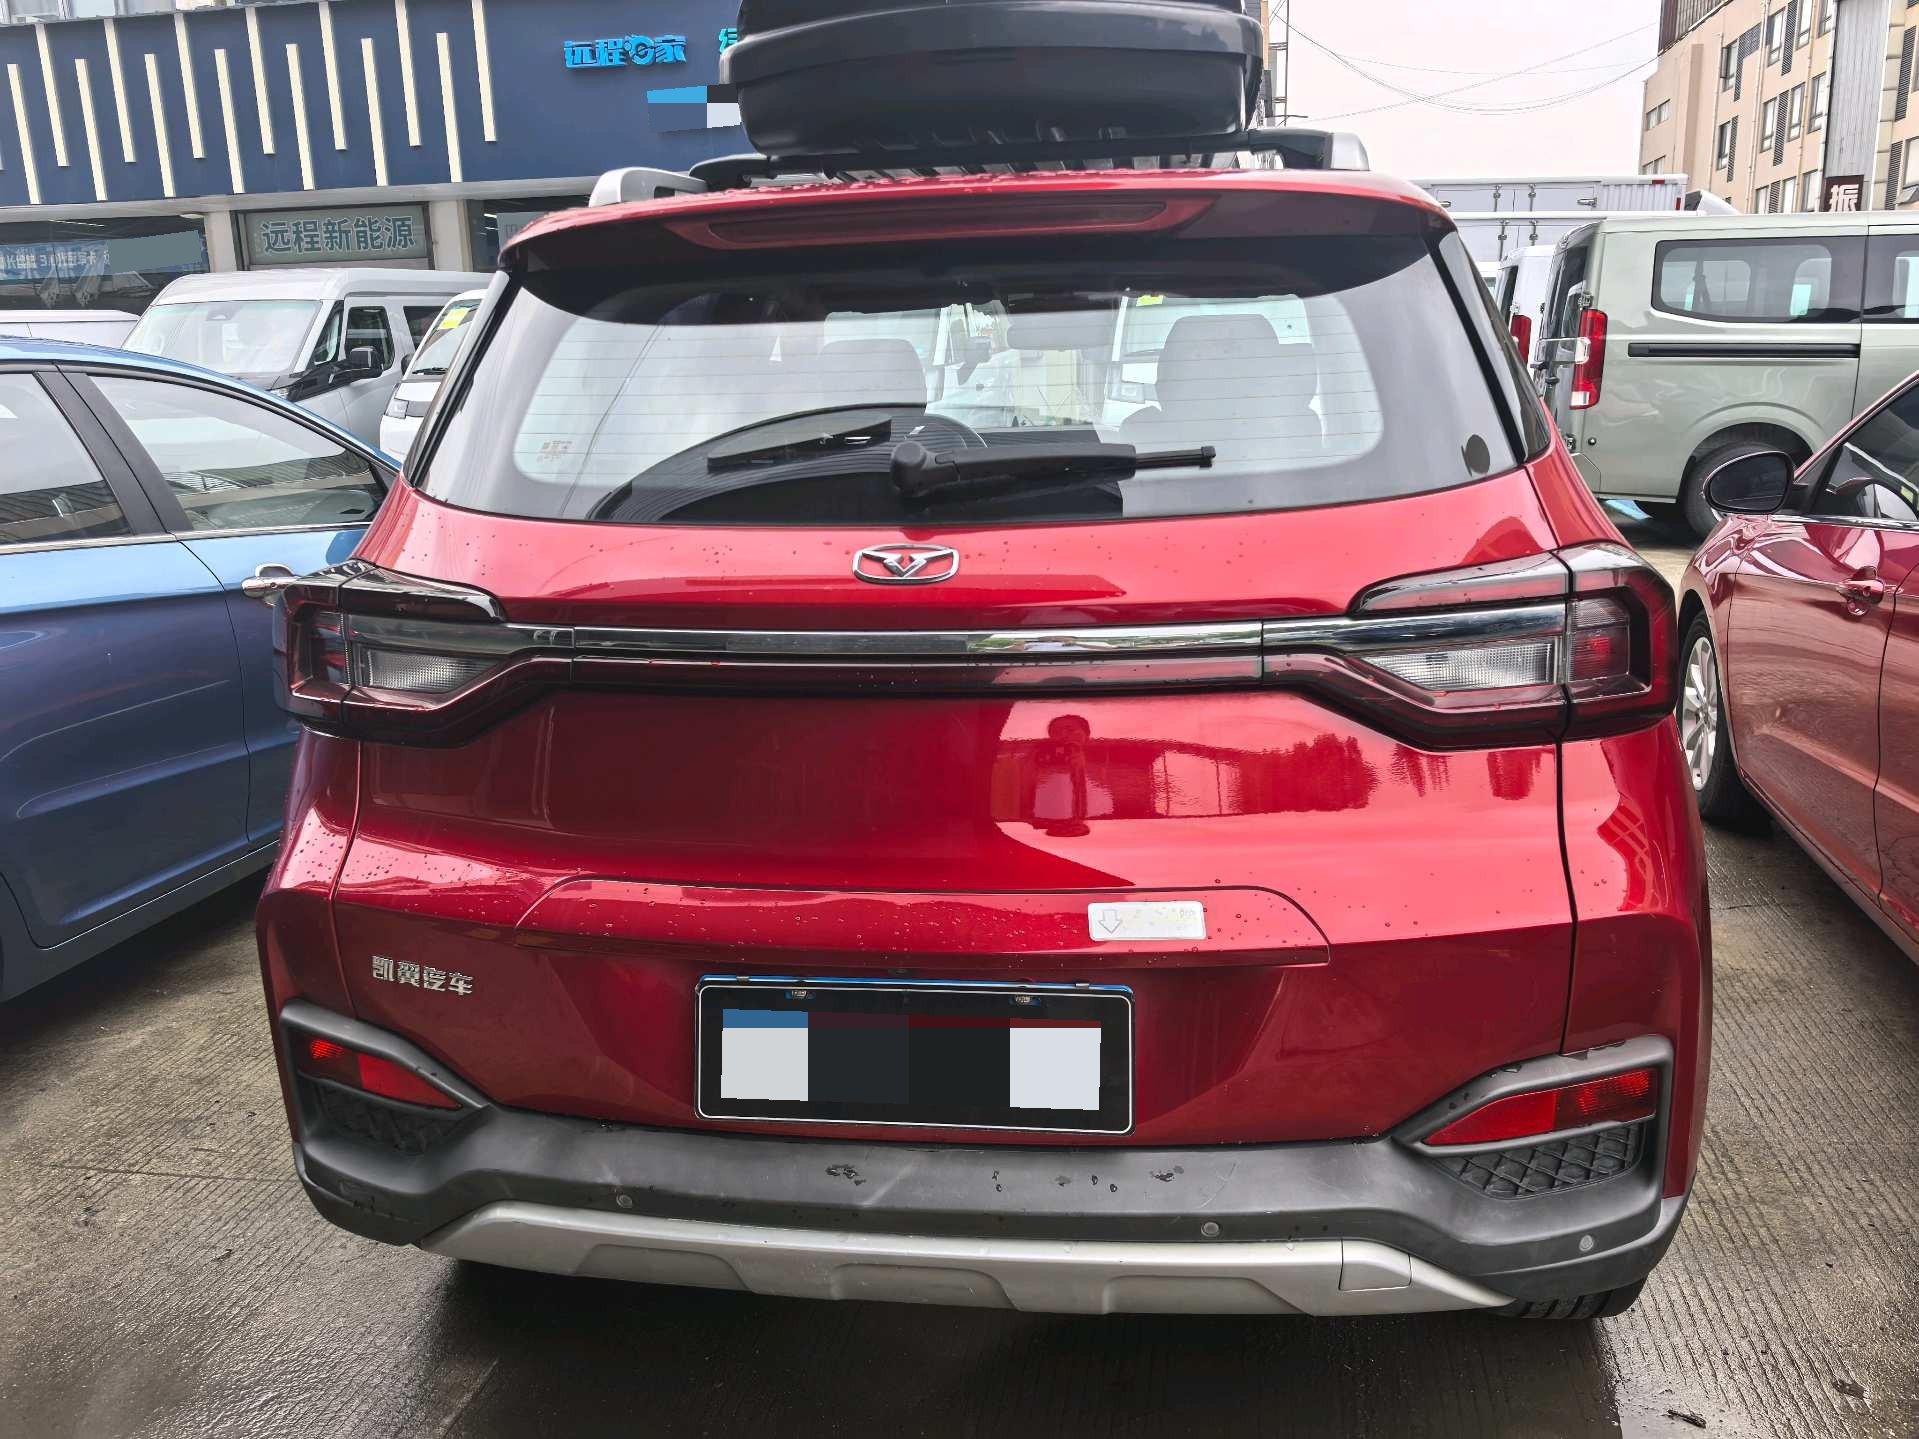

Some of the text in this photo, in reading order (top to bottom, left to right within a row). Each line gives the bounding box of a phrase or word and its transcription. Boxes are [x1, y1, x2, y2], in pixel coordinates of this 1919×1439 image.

[261, 215, 415, 254] 远程新能源
[372, 955, 473, 995] 凯翼汽车
